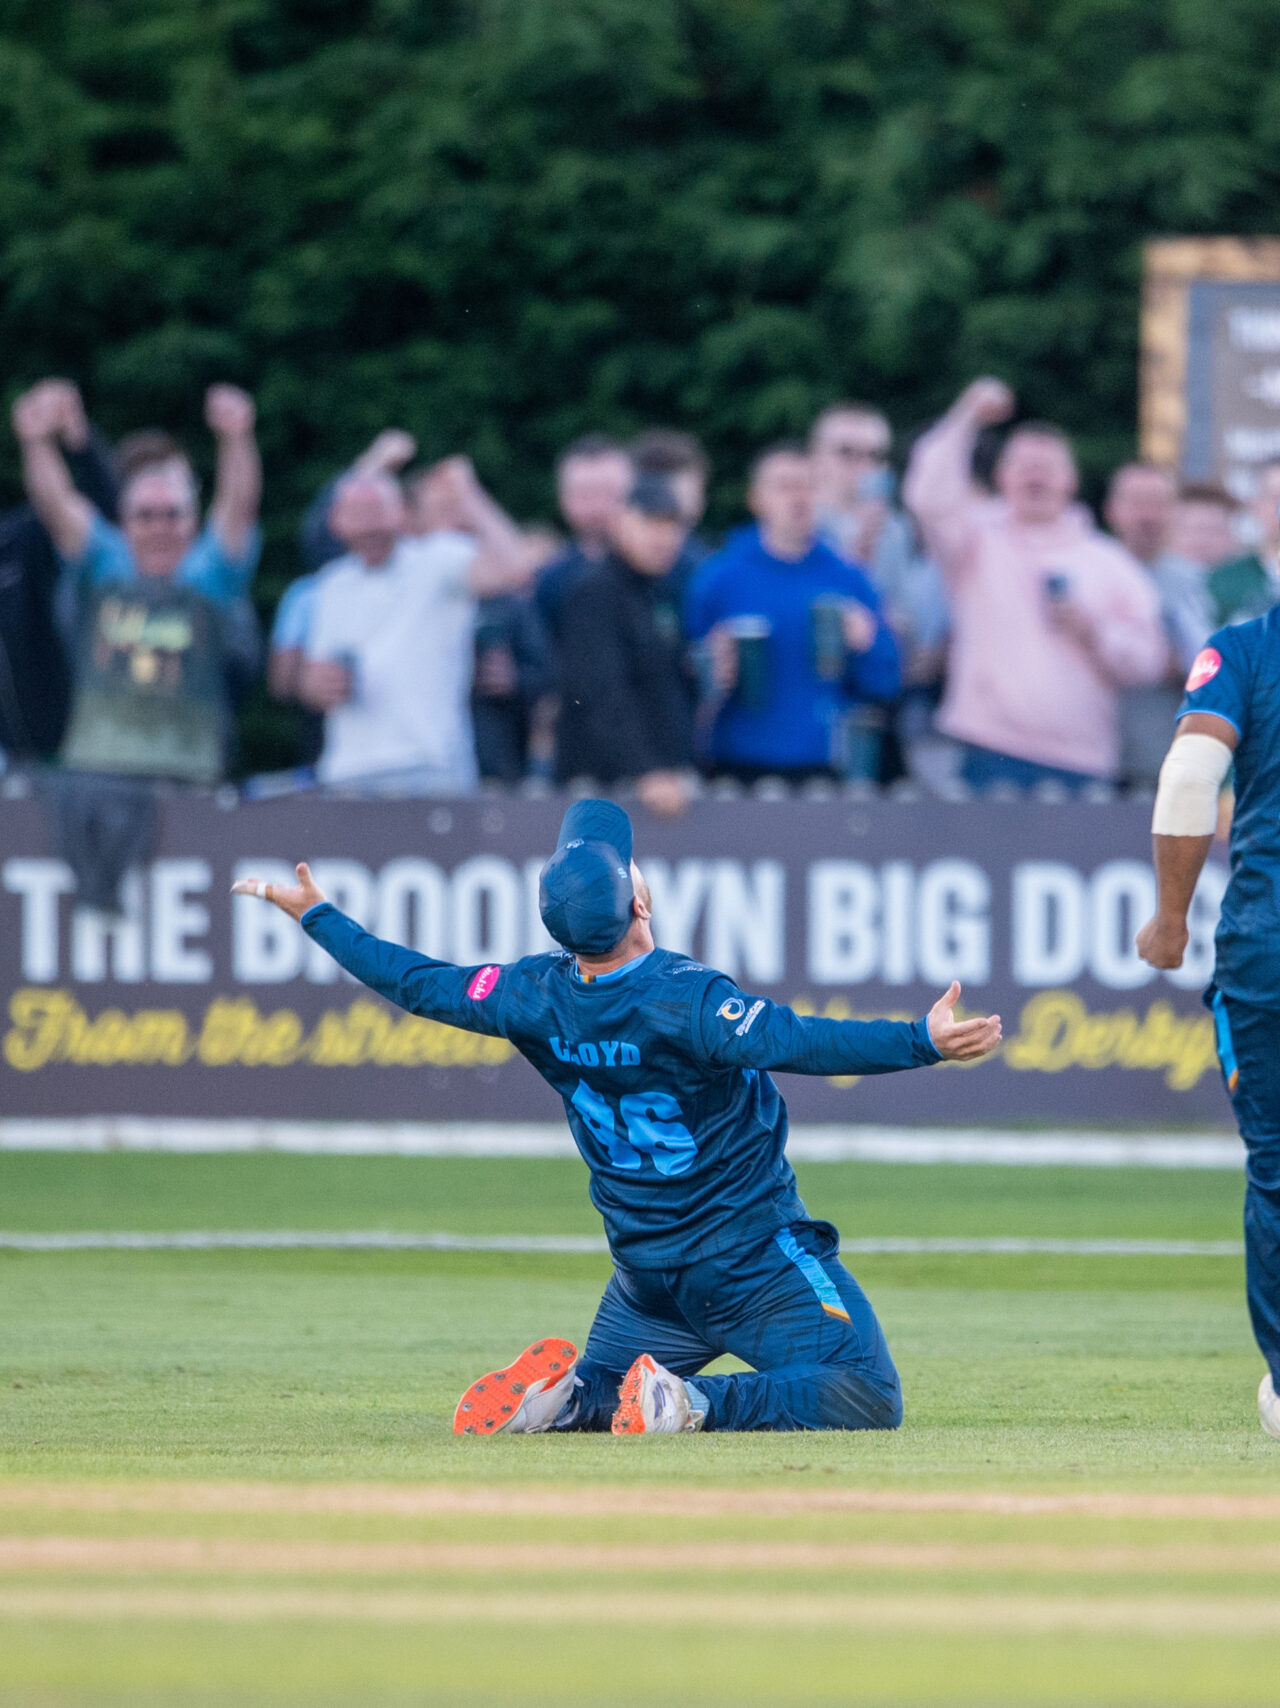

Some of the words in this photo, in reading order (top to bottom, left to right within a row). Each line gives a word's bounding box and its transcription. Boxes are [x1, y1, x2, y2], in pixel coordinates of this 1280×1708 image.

[2, 858, 213, 983] THE
[233, 855, 785, 985] BROOYN
[808, 858, 992, 986] BIG
[199, 994, 303, 1067] the
